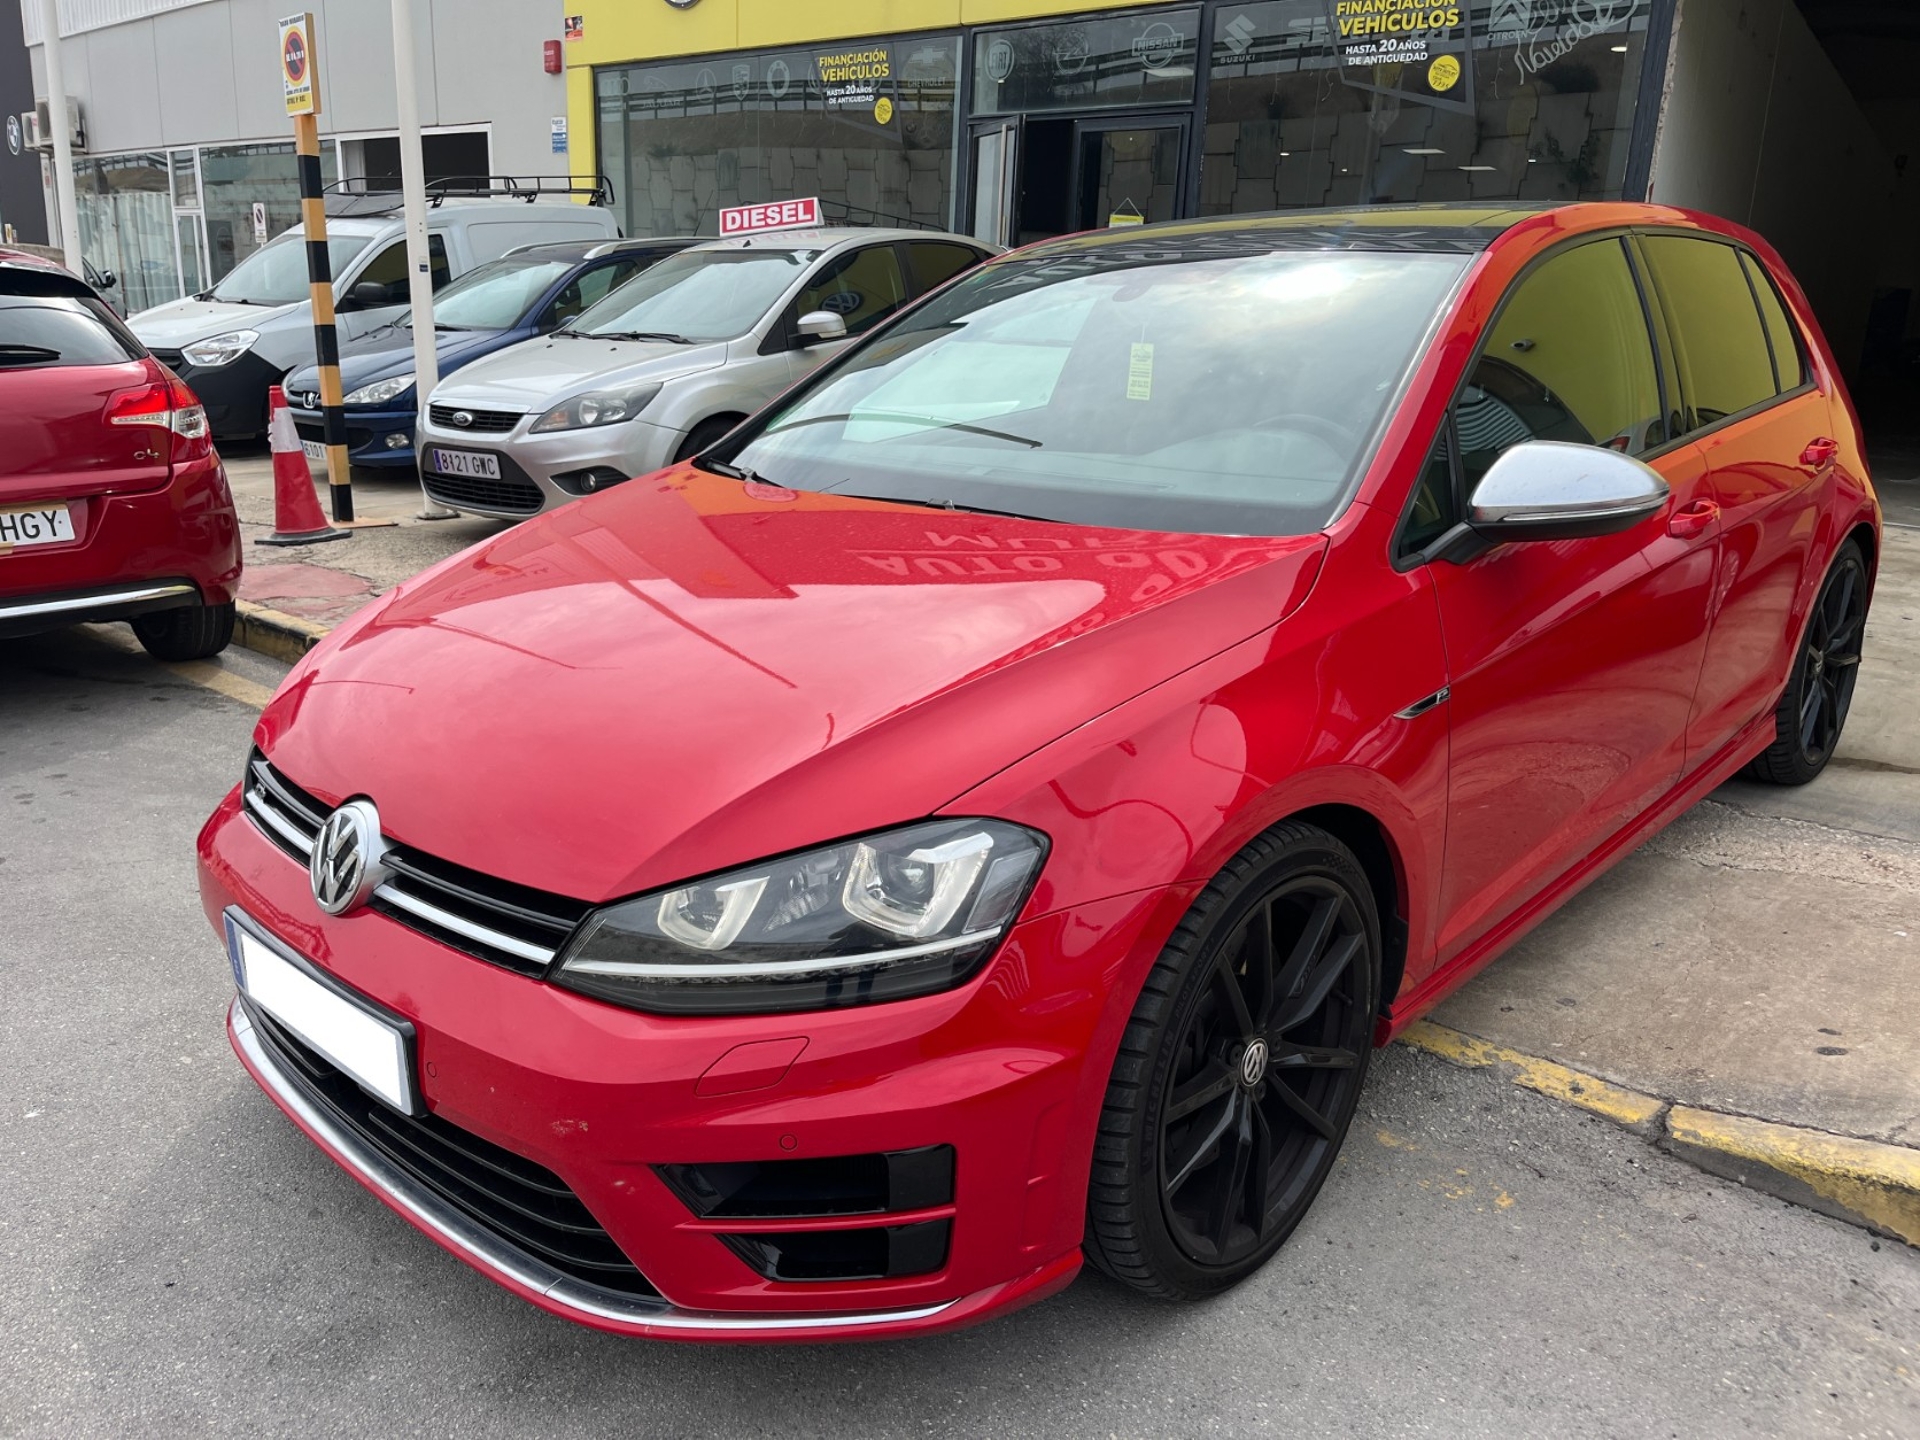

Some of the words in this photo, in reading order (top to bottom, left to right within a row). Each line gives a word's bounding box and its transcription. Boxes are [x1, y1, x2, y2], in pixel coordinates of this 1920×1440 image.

[1339, 8, 1460, 36] VEHÍCULOS
[1138, 36, 1178, 51] NISSAN
[1345, 44, 1377, 55] HASTA
[1378, 38, 1398, 53] 20
[1397, 39, 1426, 51] AÑOS
[819, 48, 888, 68] FINANCIACIÓN
[1220, 54, 1256, 64] SUZUKI
[1348, 56, 1362, 66] DE
[1363, 52, 1428, 65] ANTIGUEDAD
[821, 63, 890, 83] VEHÍCULOS
[826, 88, 845, 97] HASTA
[845, 84, 856, 95] 20
[828, 97, 837, 105] DE
[725, 202, 812, 231] DIESEL
[303, 443, 324, 459] 6101
[441, 452, 470, 473] 8121
[0, 510, 58, 541] HGY
